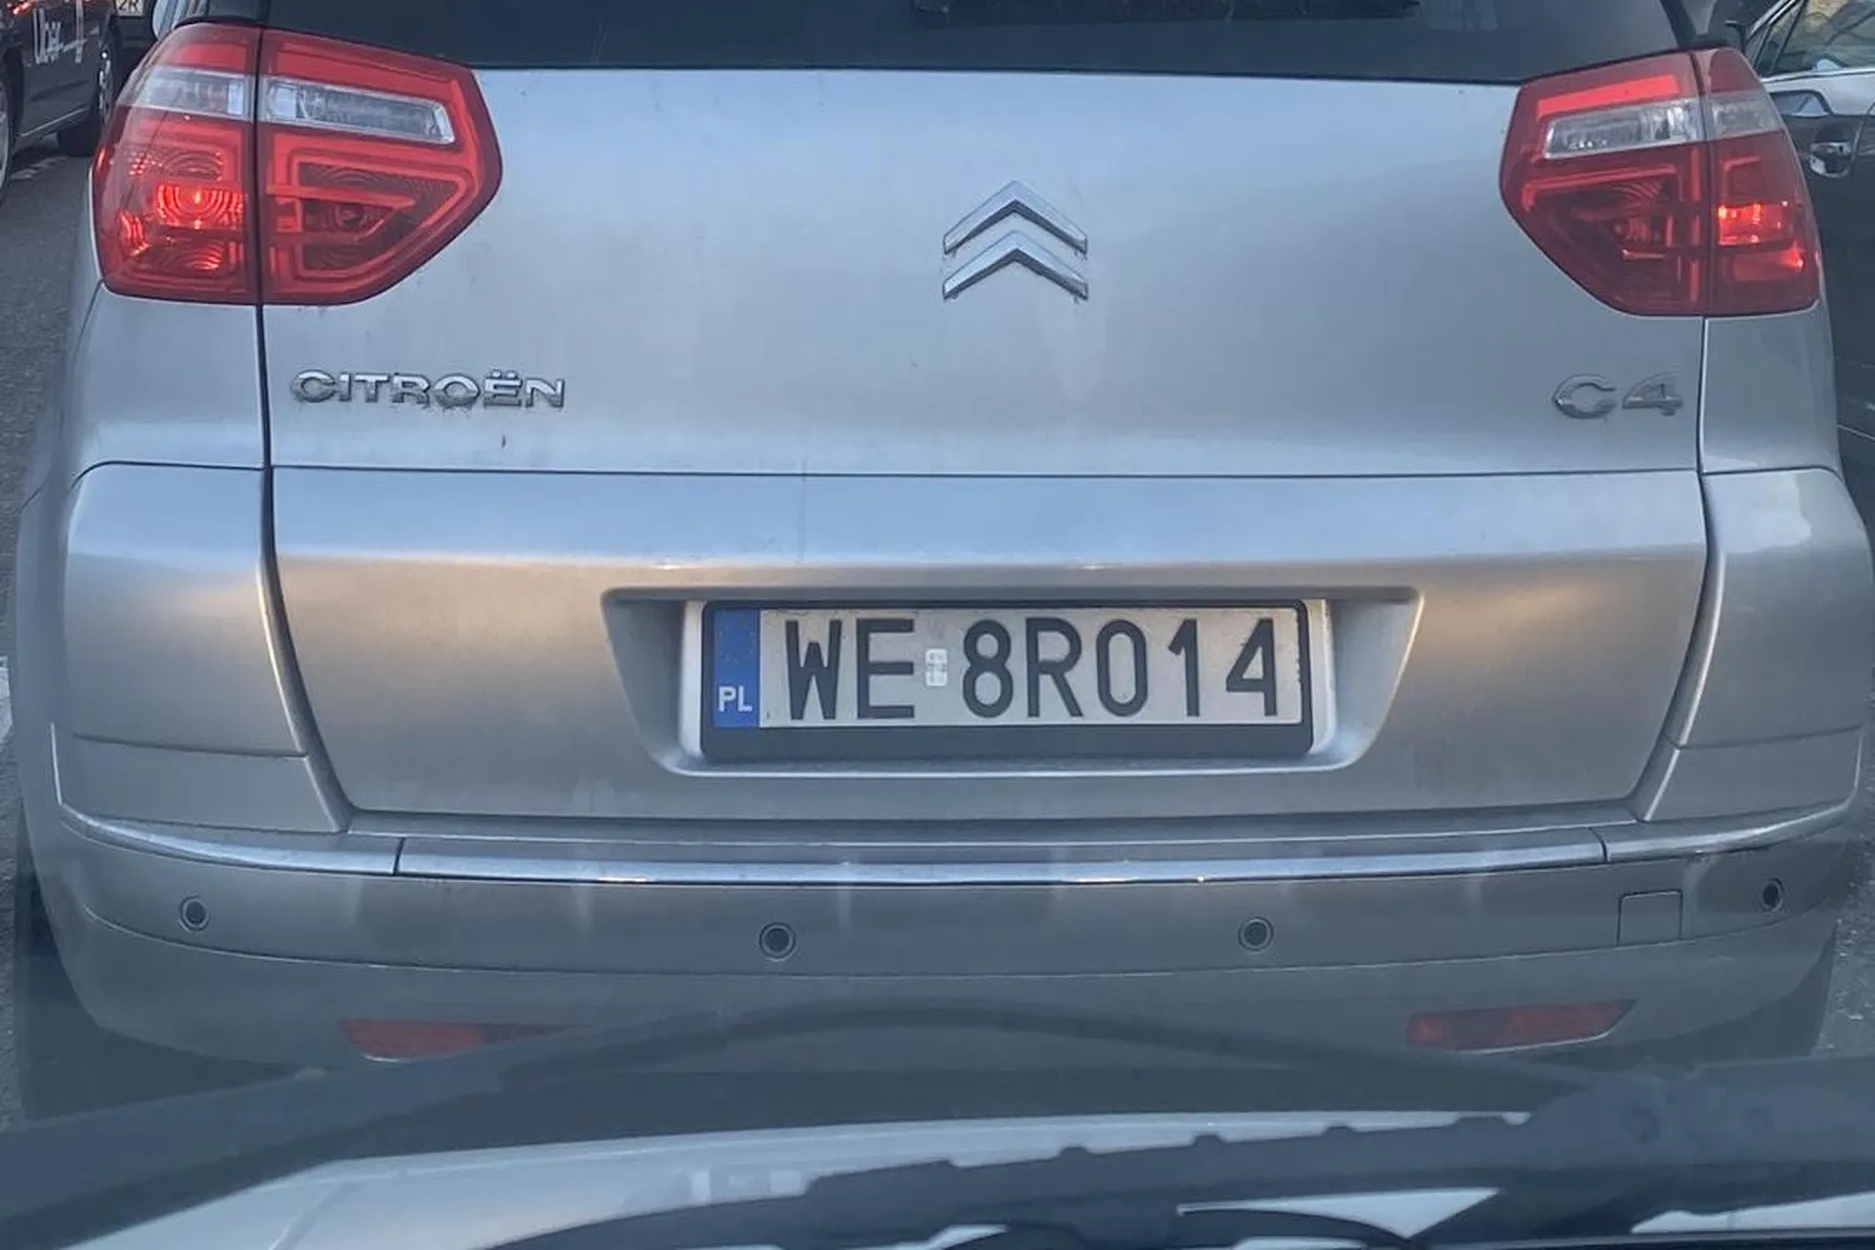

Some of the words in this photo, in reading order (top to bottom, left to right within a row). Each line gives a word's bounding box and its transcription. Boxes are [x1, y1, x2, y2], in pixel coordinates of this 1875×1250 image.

[291, 369, 566, 408] CITROËN
[1552, 372, 1684, 419] C4
[786, 618, 916, 720] WE
[961, 617, 1280, 719] 8R014
[718, 685, 753, 712] PL
